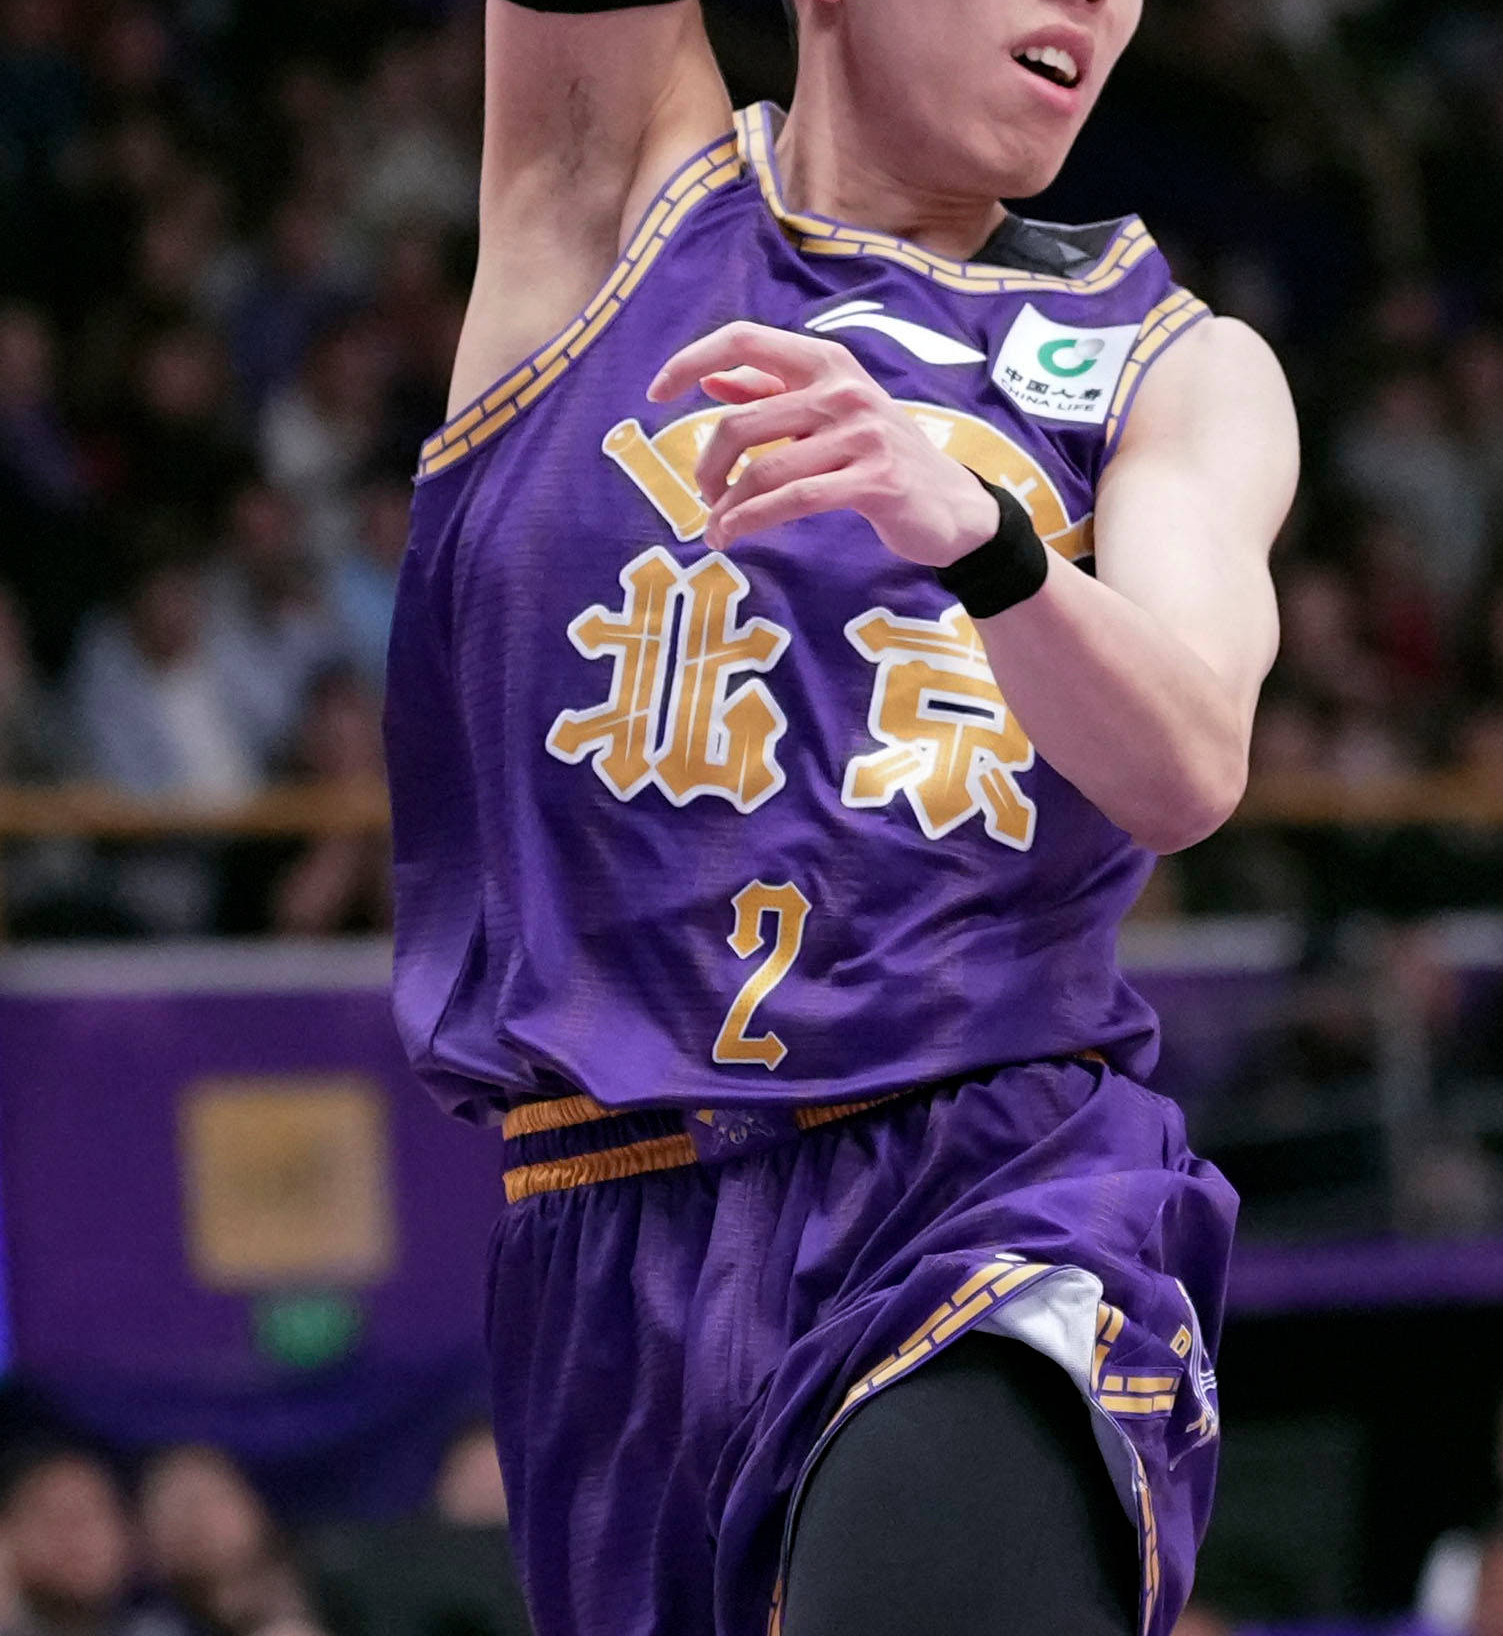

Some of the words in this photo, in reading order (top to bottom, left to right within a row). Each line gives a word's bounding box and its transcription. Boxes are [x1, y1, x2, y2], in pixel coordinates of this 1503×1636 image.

[1001, 378, 1050, 407] CHINA
[1057, 403, 1096, 412] LIFE
[1005, 366, 1103, 400] 中国人寿
[546, 545, 1037, 851] 北京
[712, 879, 811, 1071] 2
